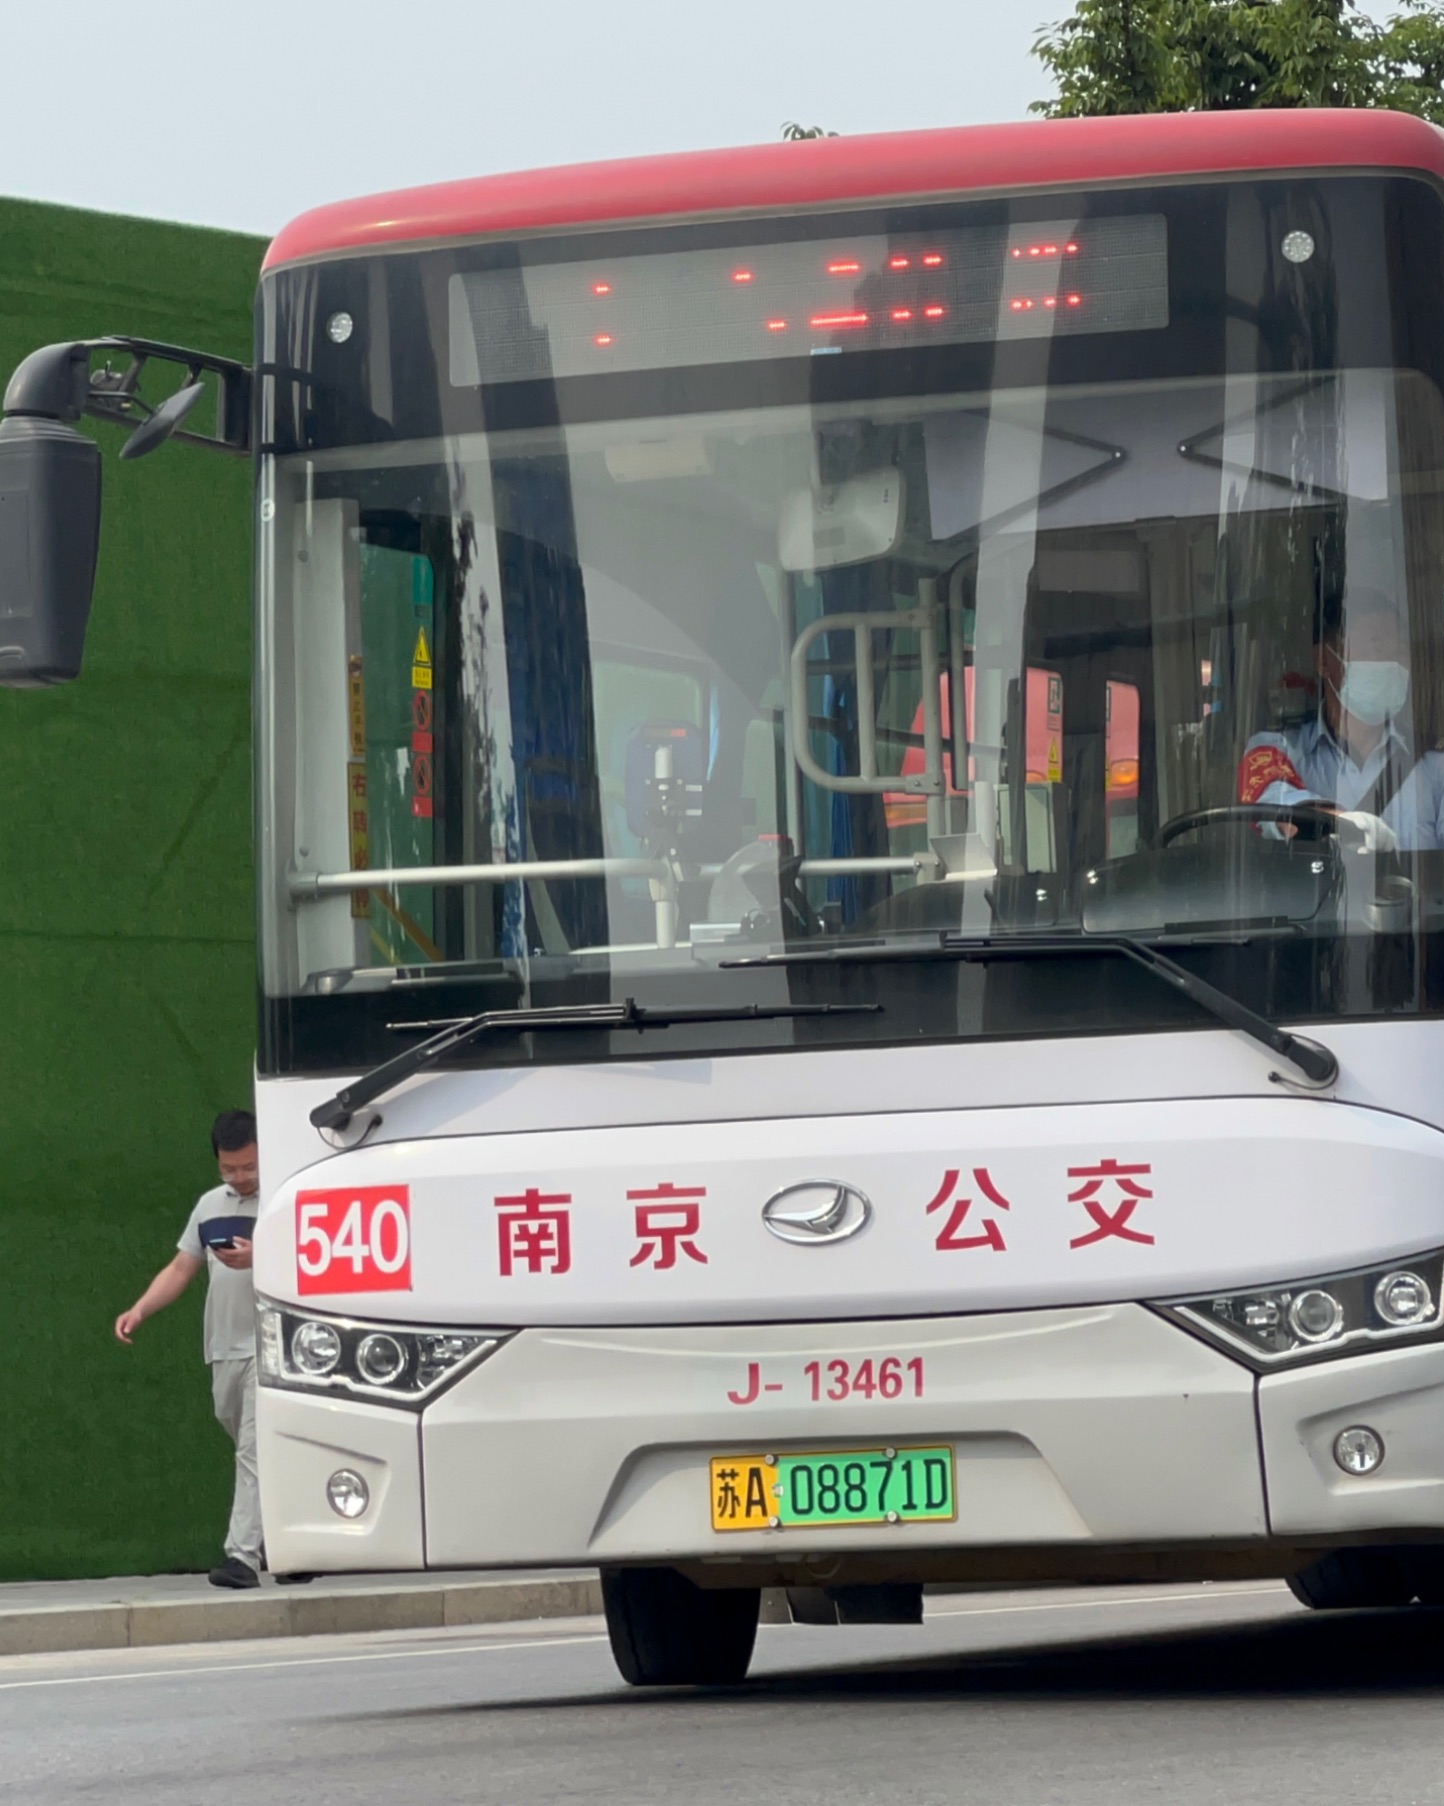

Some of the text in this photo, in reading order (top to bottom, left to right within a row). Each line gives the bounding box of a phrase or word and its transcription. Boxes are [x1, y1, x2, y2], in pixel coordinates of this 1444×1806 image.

[297, 1198, 410, 1276] 540
[493, 1157, 1157, 1277] 南京 公交
[803, 1356, 924, 1402] 13461
